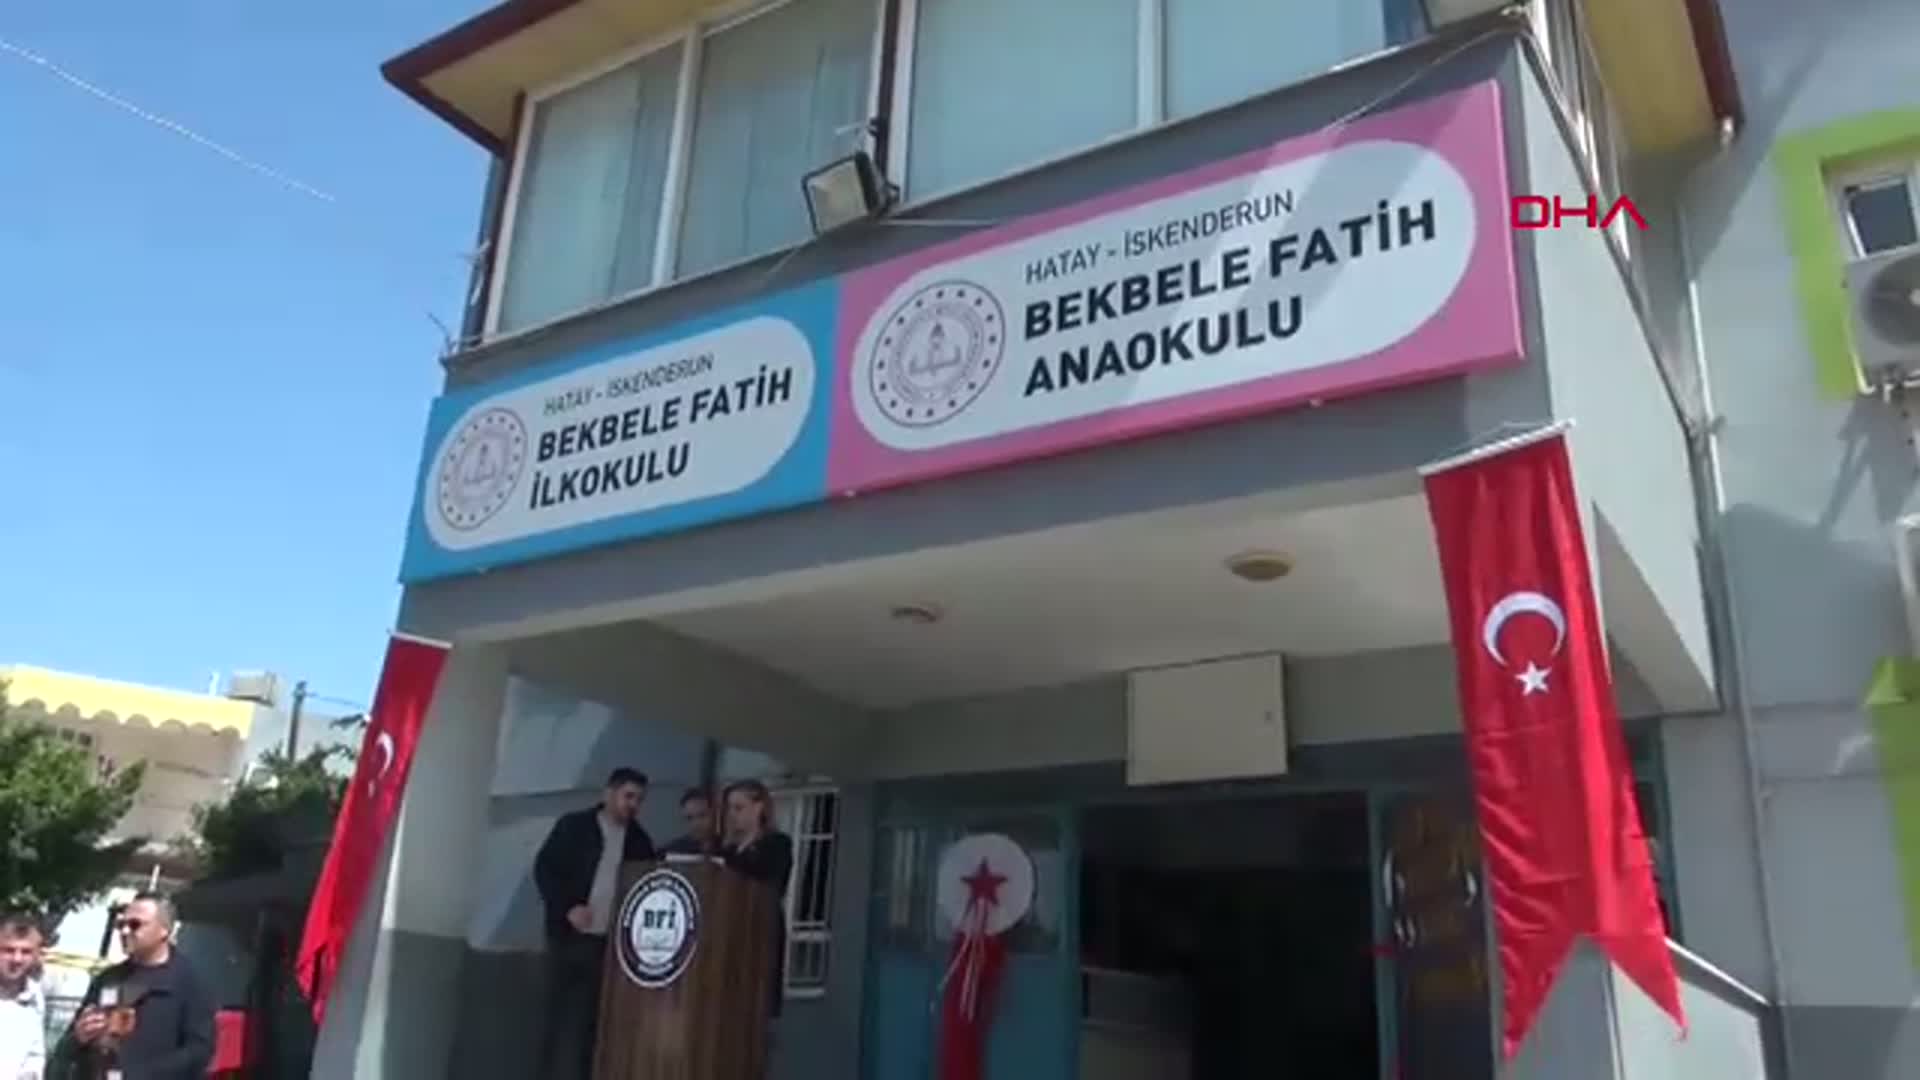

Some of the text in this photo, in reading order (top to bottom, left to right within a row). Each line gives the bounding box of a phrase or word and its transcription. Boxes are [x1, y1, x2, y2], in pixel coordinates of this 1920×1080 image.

[1024, 199, 1436, 340] BEKBELE FATİH
[1026, 245, 1101, 284] HATAY
[1124, 190, 1293, 257] İSKENDERUN
[1024, 296, 1303, 397] ANAOKULU
[537, 364, 792, 462] BEKBELE FATİH
[543, 387, 593, 415] HATAY
[529, 443, 690, 509] İLKOKULU
